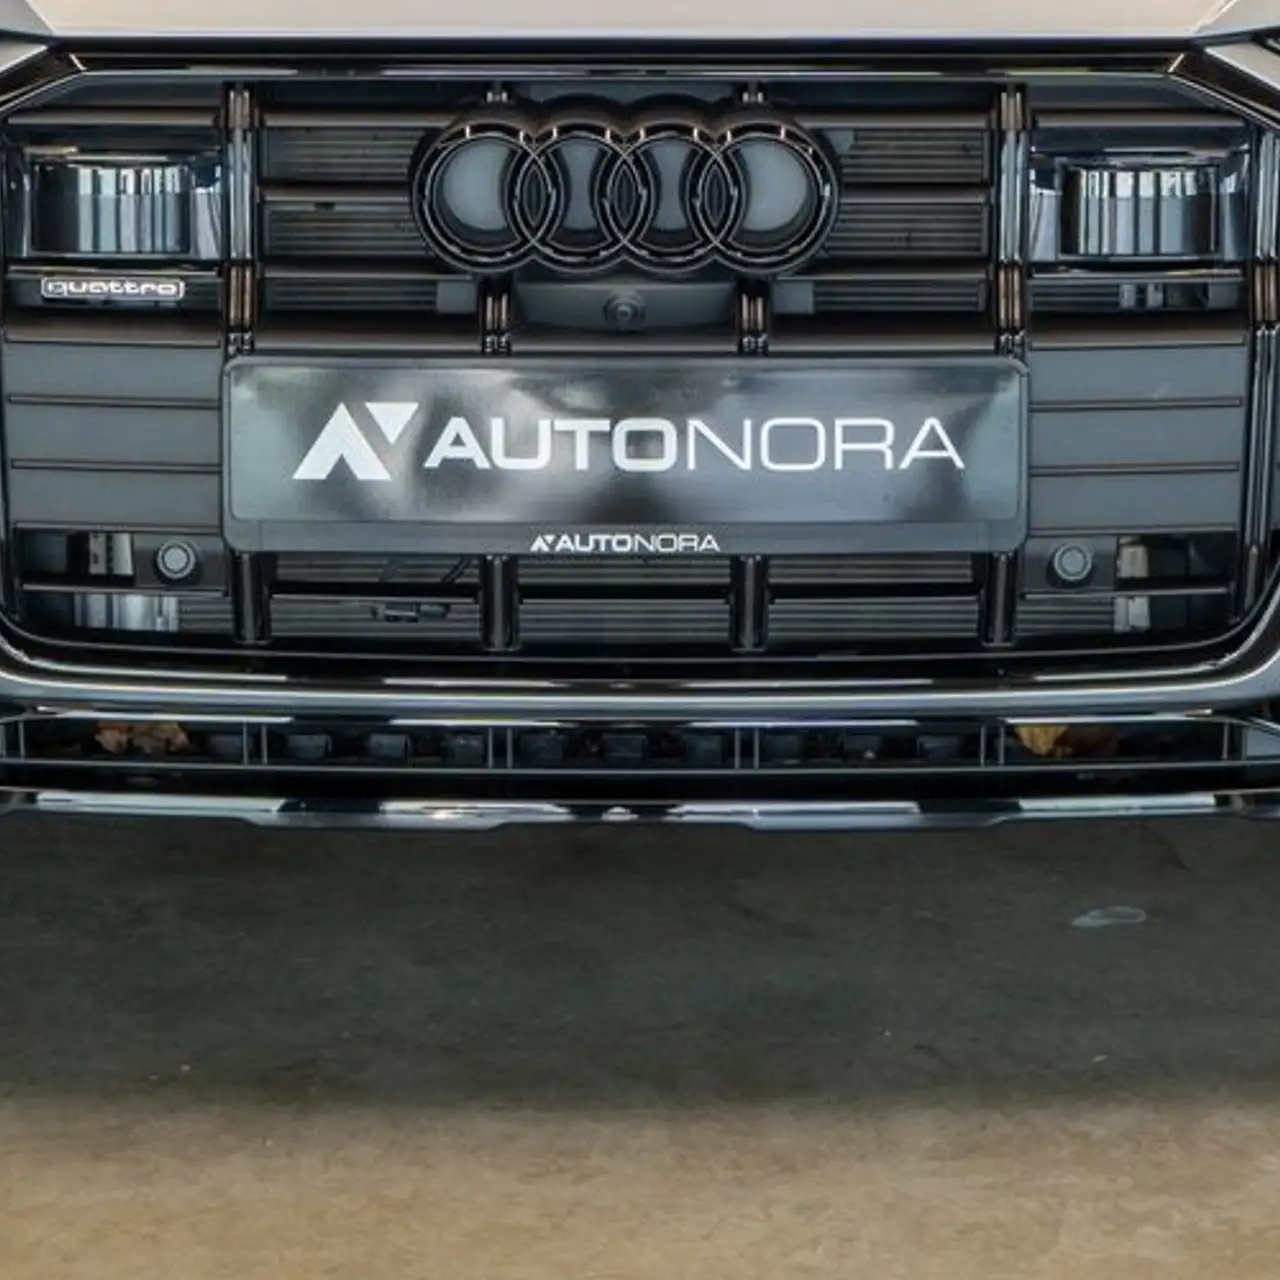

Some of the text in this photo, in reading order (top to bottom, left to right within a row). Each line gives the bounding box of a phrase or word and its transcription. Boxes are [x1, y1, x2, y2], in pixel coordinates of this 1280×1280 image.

[47, 279, 177, 297] quattro
[423, 416, 966, 472] AUTONORA
[554, 533, 721, 553] AUTONORA
